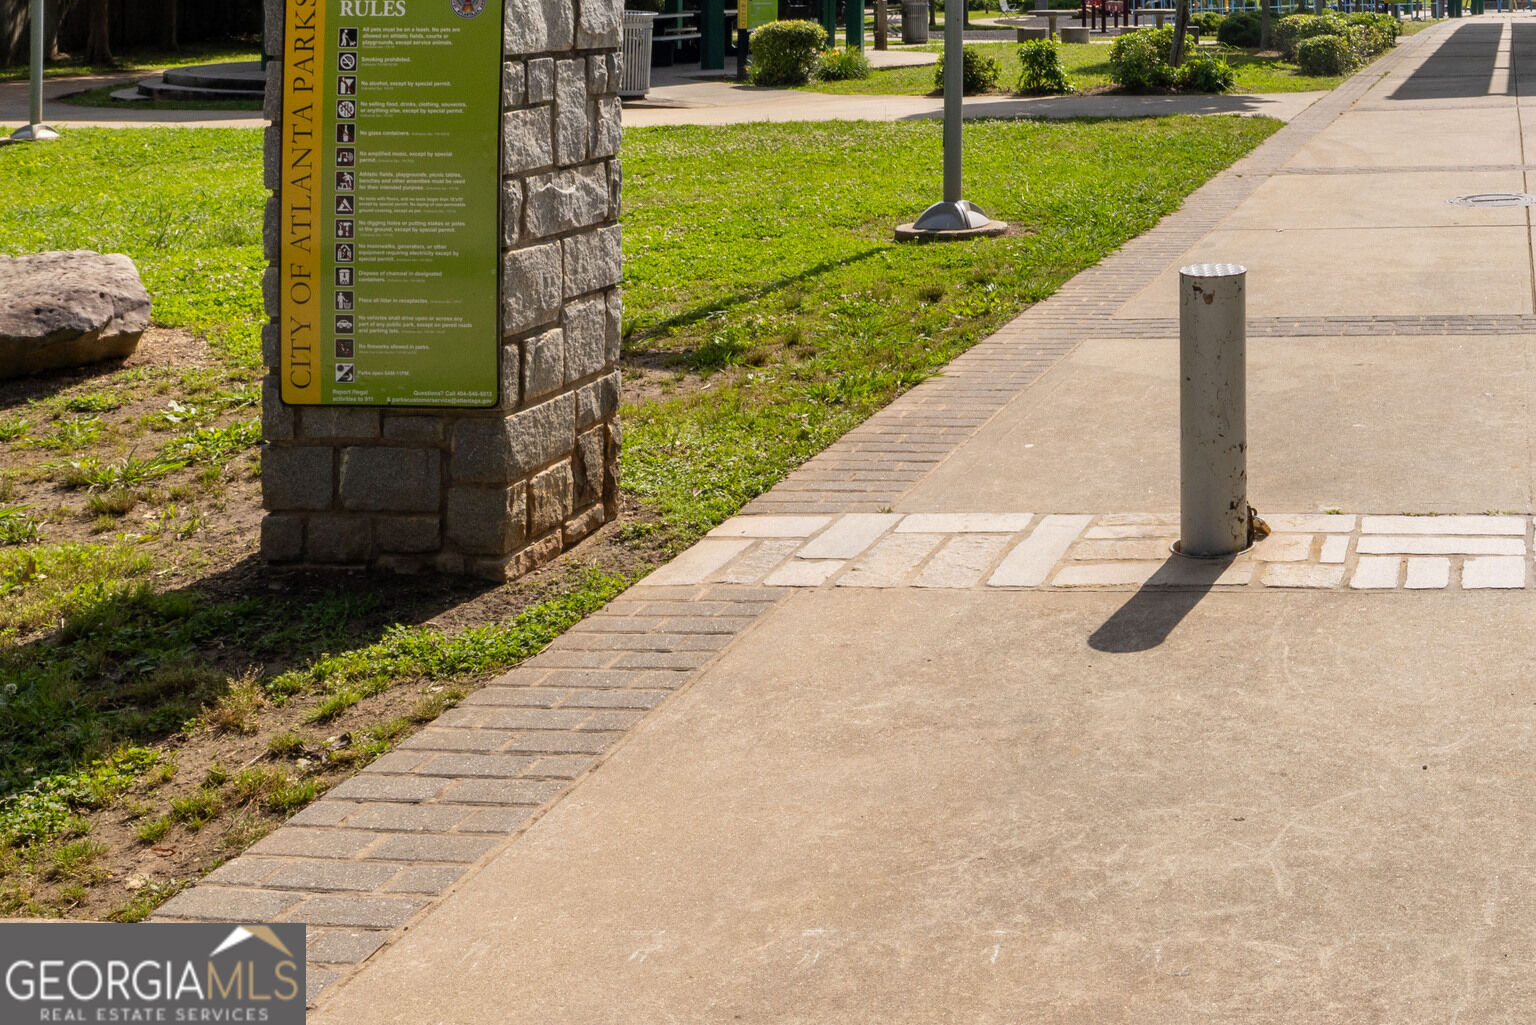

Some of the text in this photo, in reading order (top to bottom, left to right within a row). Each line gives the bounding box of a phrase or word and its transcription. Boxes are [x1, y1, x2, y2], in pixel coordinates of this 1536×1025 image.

[339, 0, 406, 17] RULES
[290, 102, 313, 253] ATLANTA
[289, 262, 312, 305] OF
[289, 317, 312, 389] CITY
